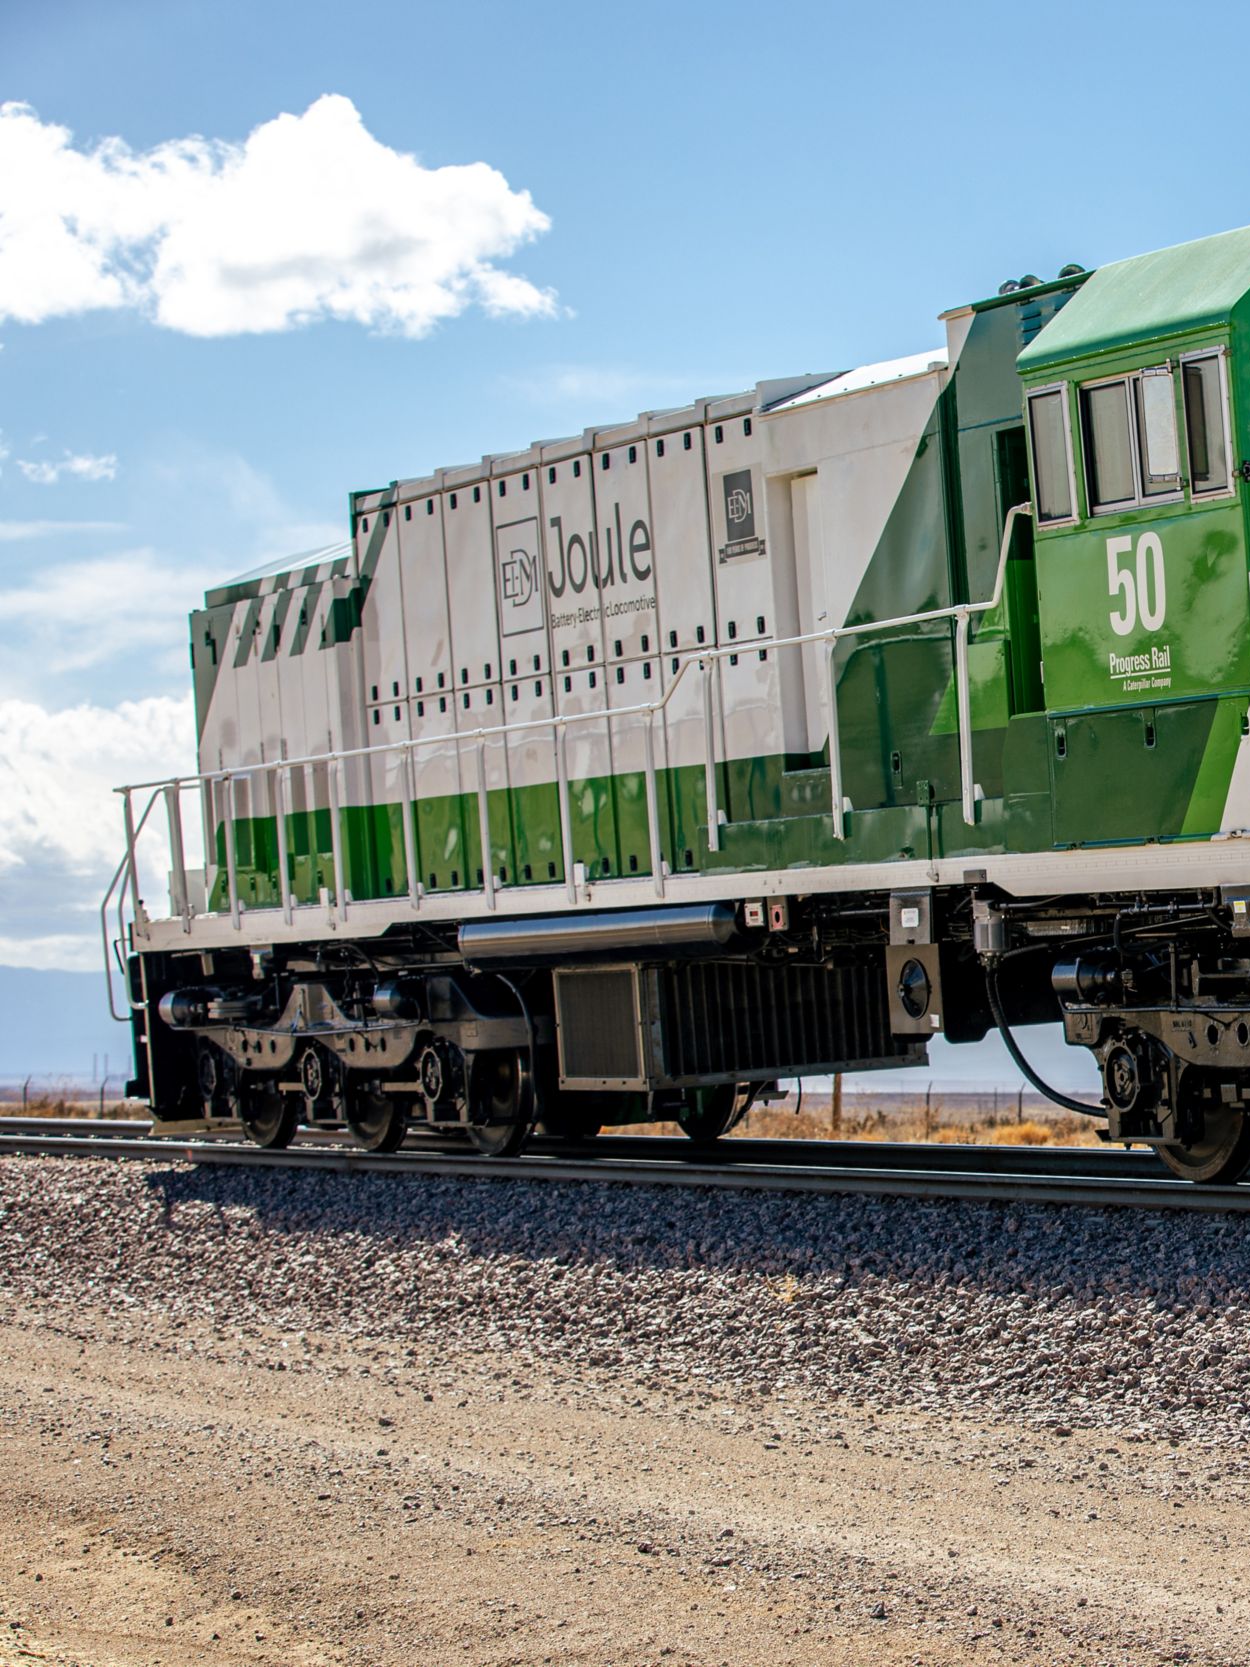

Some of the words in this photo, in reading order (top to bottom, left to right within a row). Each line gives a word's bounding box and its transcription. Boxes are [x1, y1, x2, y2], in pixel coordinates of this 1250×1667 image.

[548, 502, 652, 598] Joule
[1106, 531, 1167, 636] 50
[610, 595, 657, 617] Locomotive
[1109, 653, 1151, 677] Progress
[1151, 645, 1171, 669] Rail
[1122, 681, 1127, 692] A
[1151, 677, 1171, 690] Company
